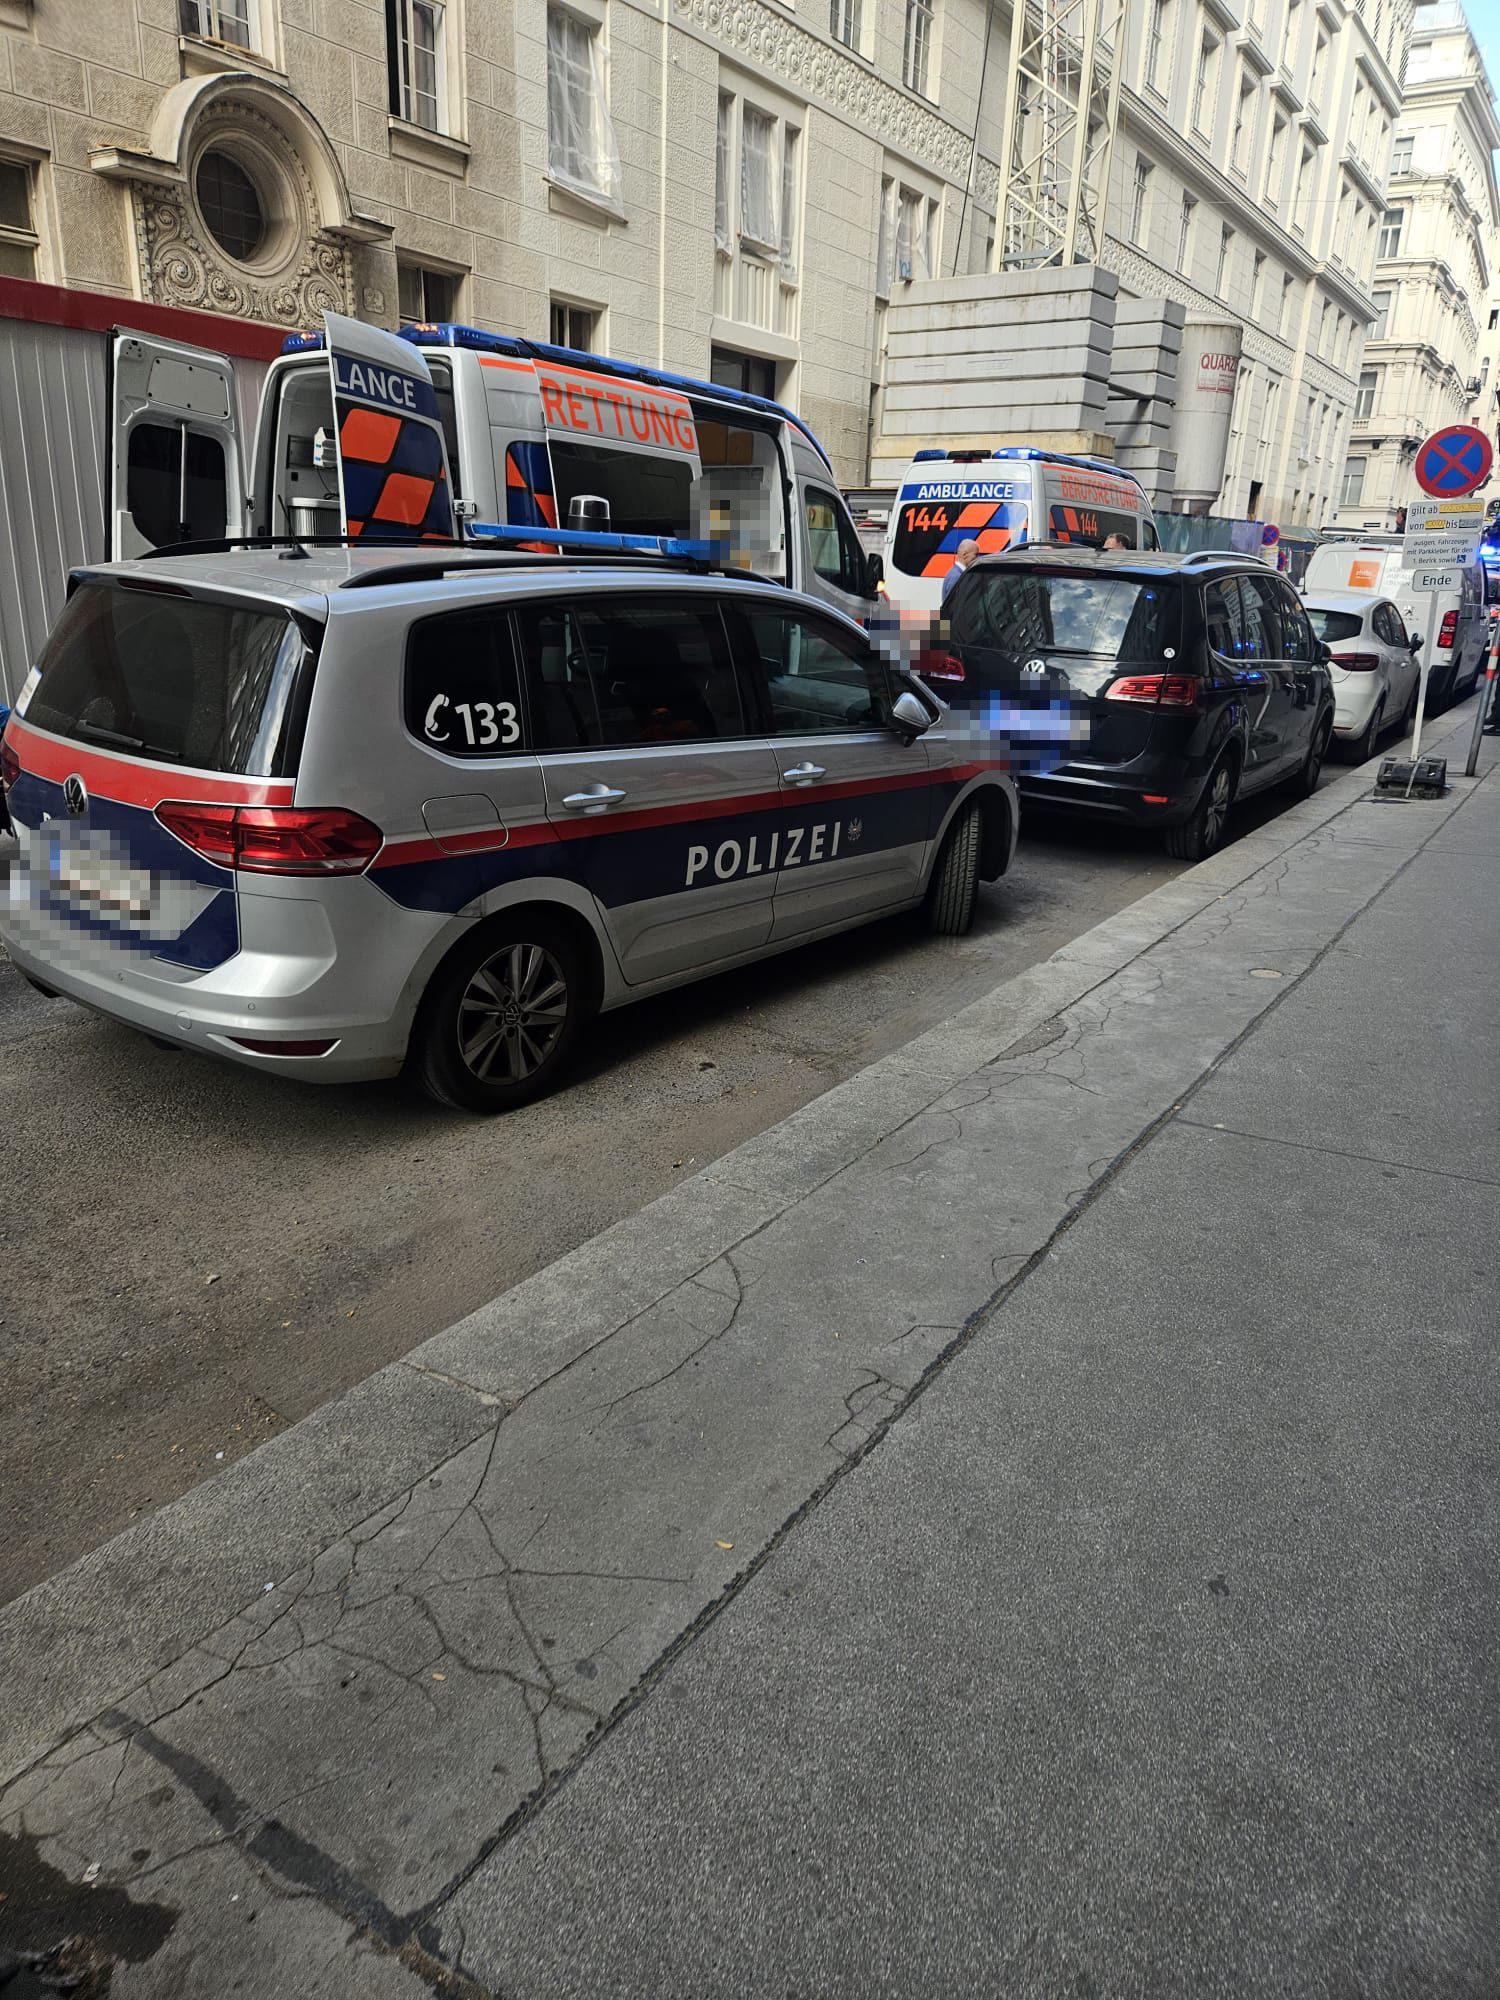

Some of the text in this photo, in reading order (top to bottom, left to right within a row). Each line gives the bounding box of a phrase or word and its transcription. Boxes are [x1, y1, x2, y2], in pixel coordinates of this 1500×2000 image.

[332, 356, 417, 408] LANCE
[540, 377, 695, 450] RETTUNG
[918, 483, 1014, 499] AMBULANCE
[1061, 475, 1138, 510] BERUFSRETTUNG
[905, 506, 948, 532] 144
[1411, 506, 1426, 516] gilt
[1427, 505, 1438, 514] ab
[1080, 512, 1098, 537] 144
[1445, 519, 1458, 529] bis
[1437, 538, 1469, 546] Fahrzeuge
[1422, 575, 1452, 586] Ende
[454, 701, 520, 745] 133
[684, 821, 842, 886] POLIZEI
